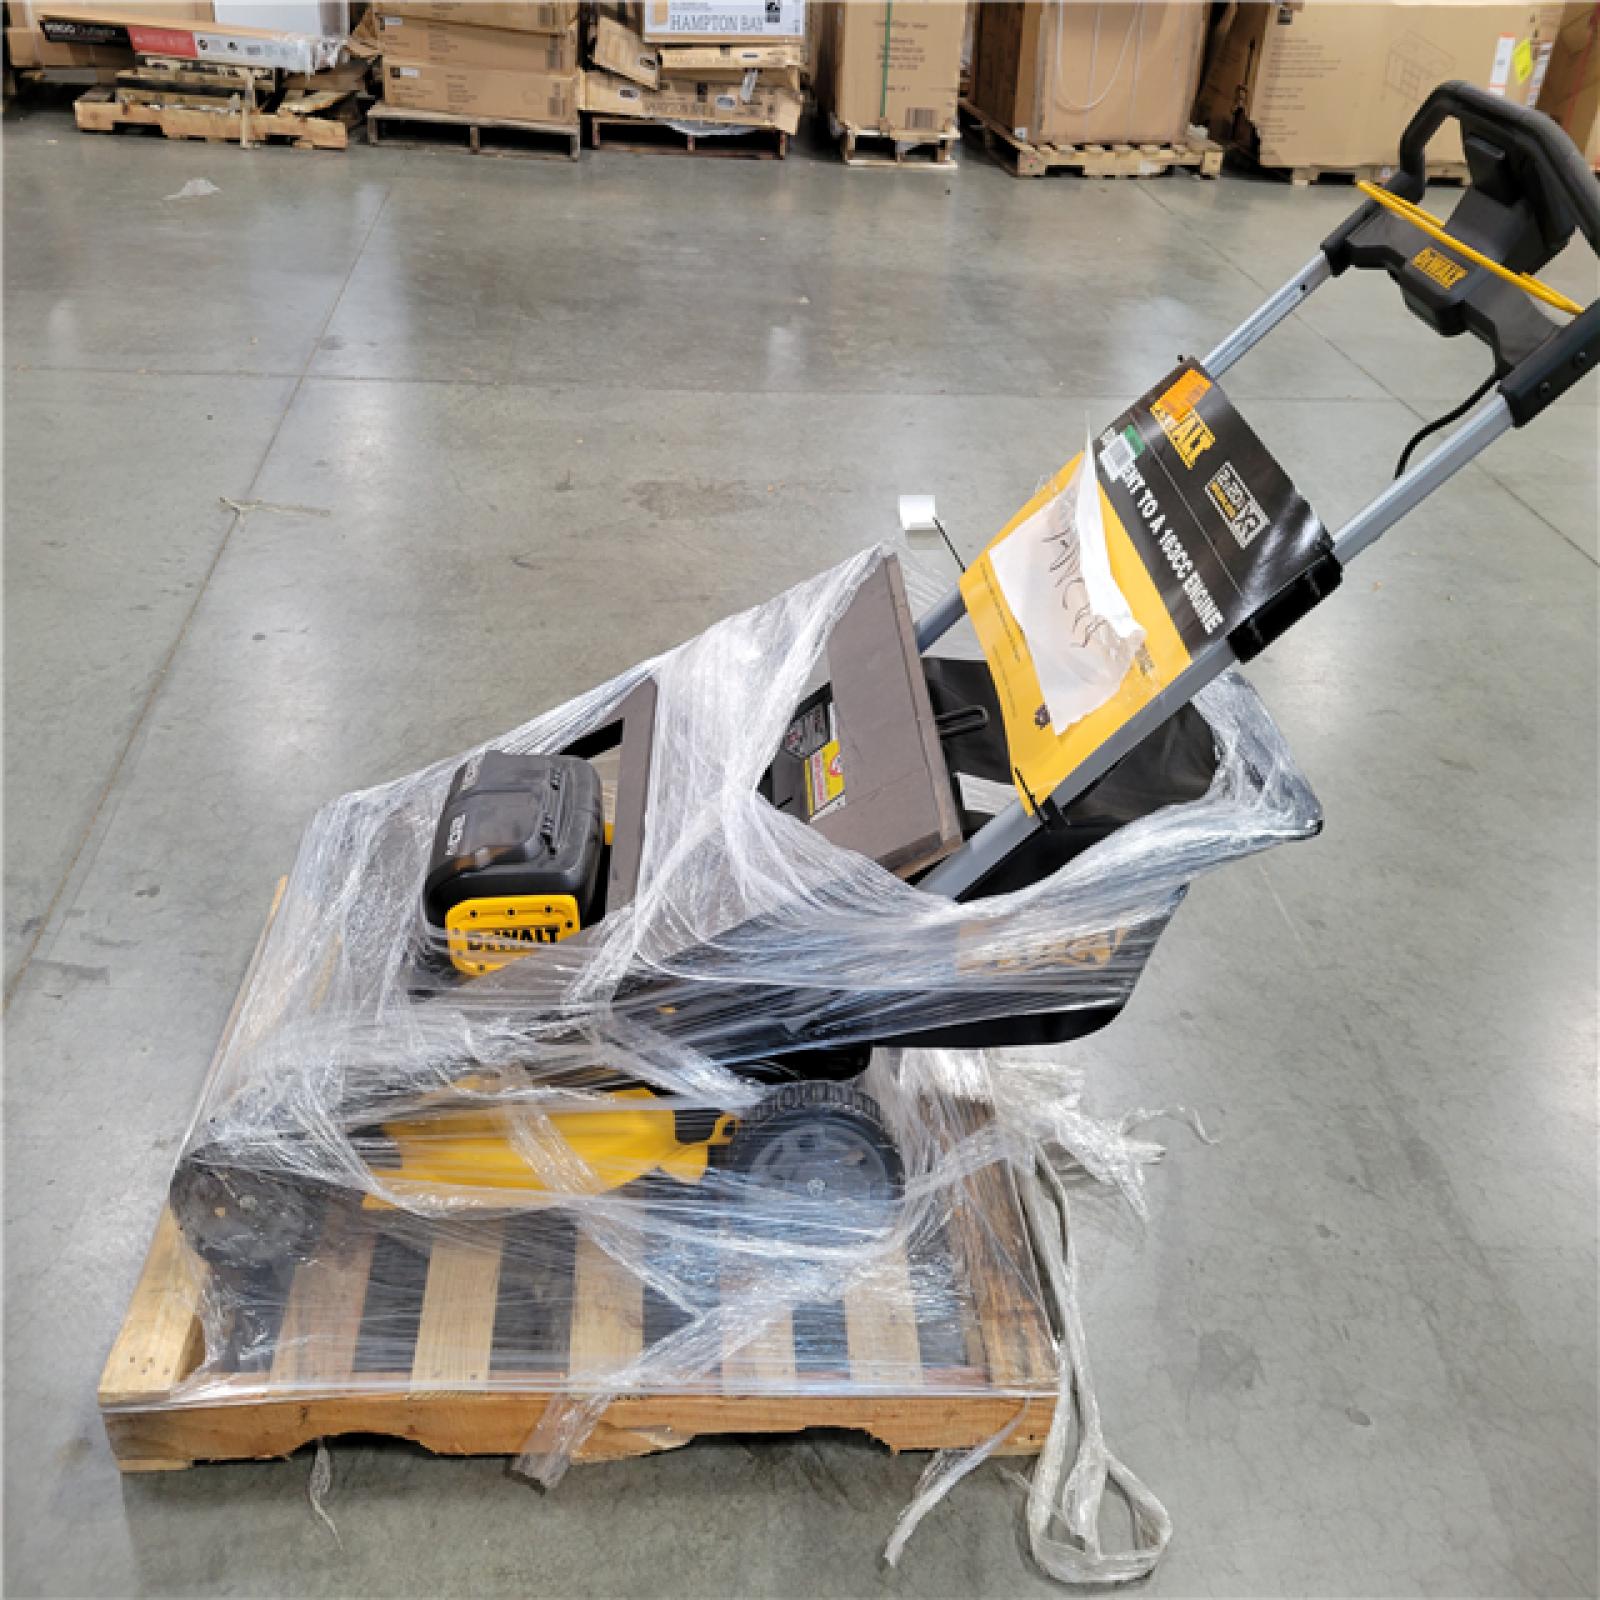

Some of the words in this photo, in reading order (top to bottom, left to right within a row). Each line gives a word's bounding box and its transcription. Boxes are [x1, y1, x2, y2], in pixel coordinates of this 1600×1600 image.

[670, 15, 738, 31] HAMPTON
[740, 16, 764, 32] BAY
[1137, 488, 1158, 518] TO
[1149, 514, 1166, 535] A
[1182, 570, 1224, 635] ENGINE
